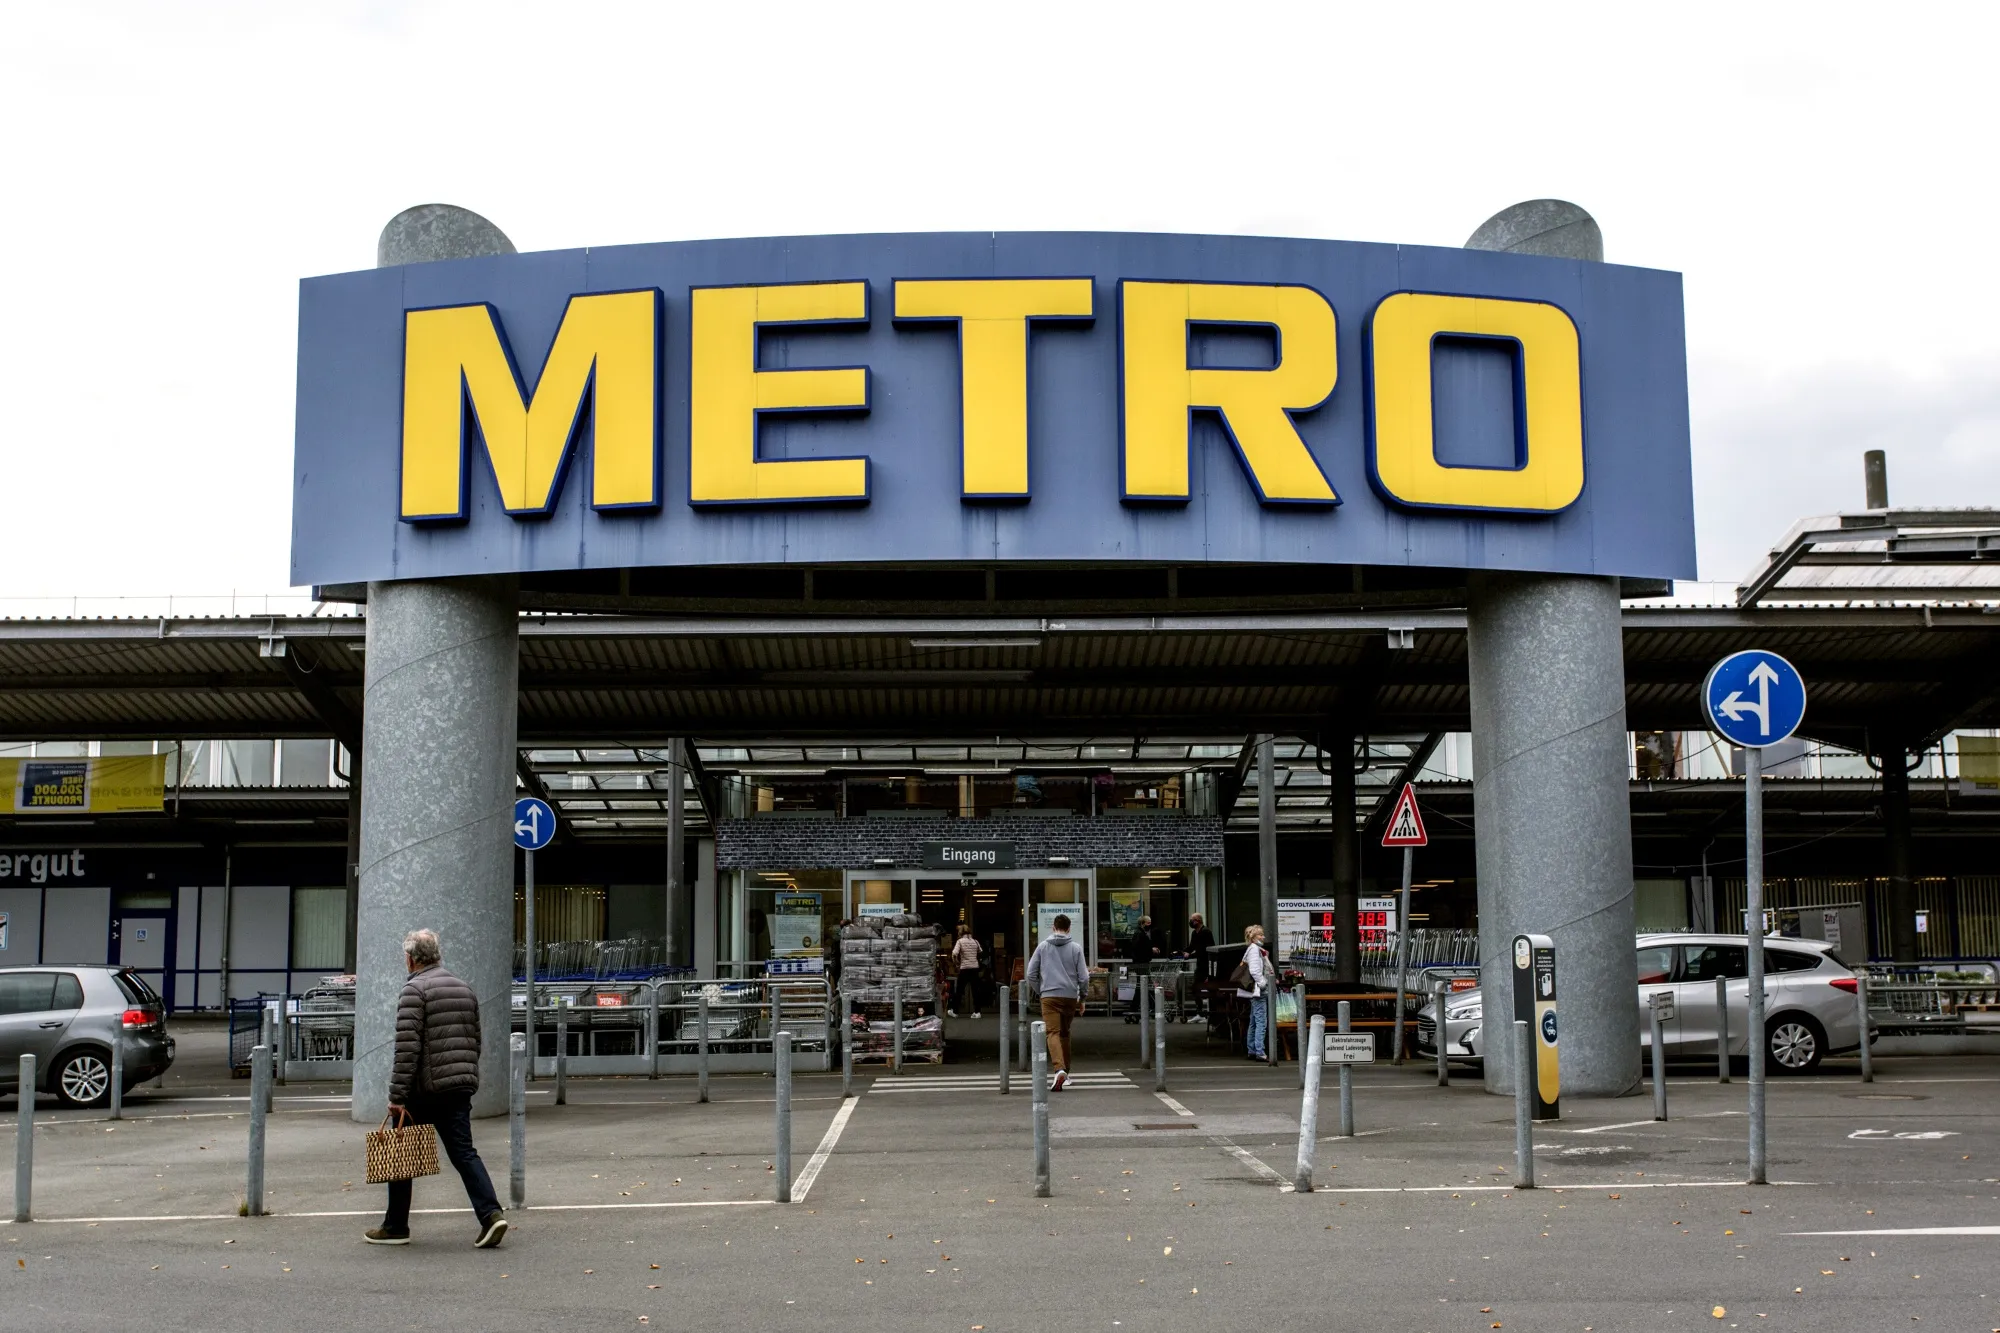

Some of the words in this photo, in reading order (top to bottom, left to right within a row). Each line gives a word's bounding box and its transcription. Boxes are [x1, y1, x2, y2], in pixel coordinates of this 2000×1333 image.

[399, 276, 1587, 525] METRO
[942, 847, 996, 864] Eingang
[782, 898, 815, 906] METRO
